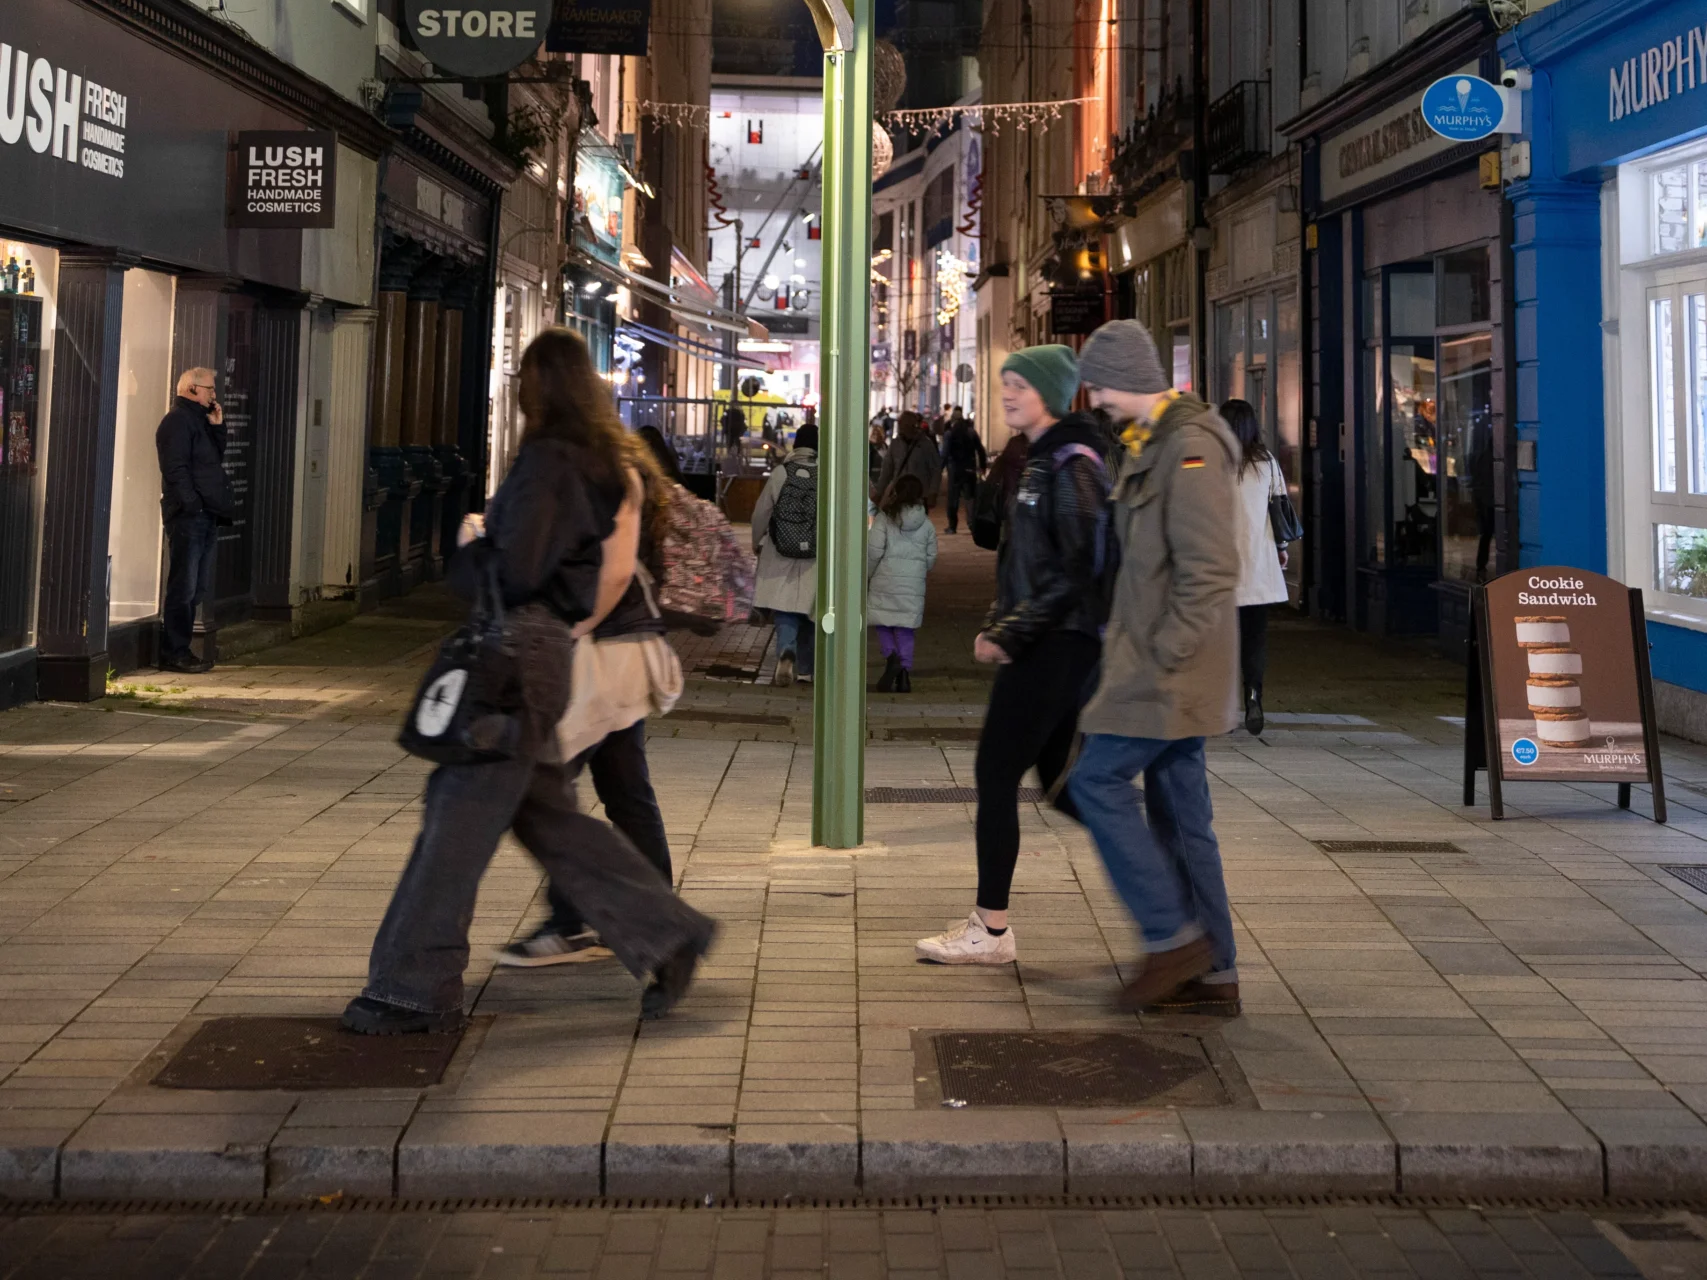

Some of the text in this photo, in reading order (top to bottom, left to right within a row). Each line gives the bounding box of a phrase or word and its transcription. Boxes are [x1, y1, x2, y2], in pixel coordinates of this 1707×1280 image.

[417, 10, 537, 39] STORE
[83, 80, 128, 129] FRESH
[1433, 114, 1492, 127] MURPHY'S
[82, 121, 125, 154] HANDMADE
[81, 147, 125, 179] COSMETICS
[248, 146, 323, 167] LUSH
[248, 168, 323, 187] FRESH
[247, 189, 322, 200] HANDMADE
[247, 201, 322, 213] COSMETICS
[1528, 576, 1584, 590] Cookie
[1518, 592, 1597, 606] Sandwich
[1583, 753, 1641, 765] MURPHY'S
